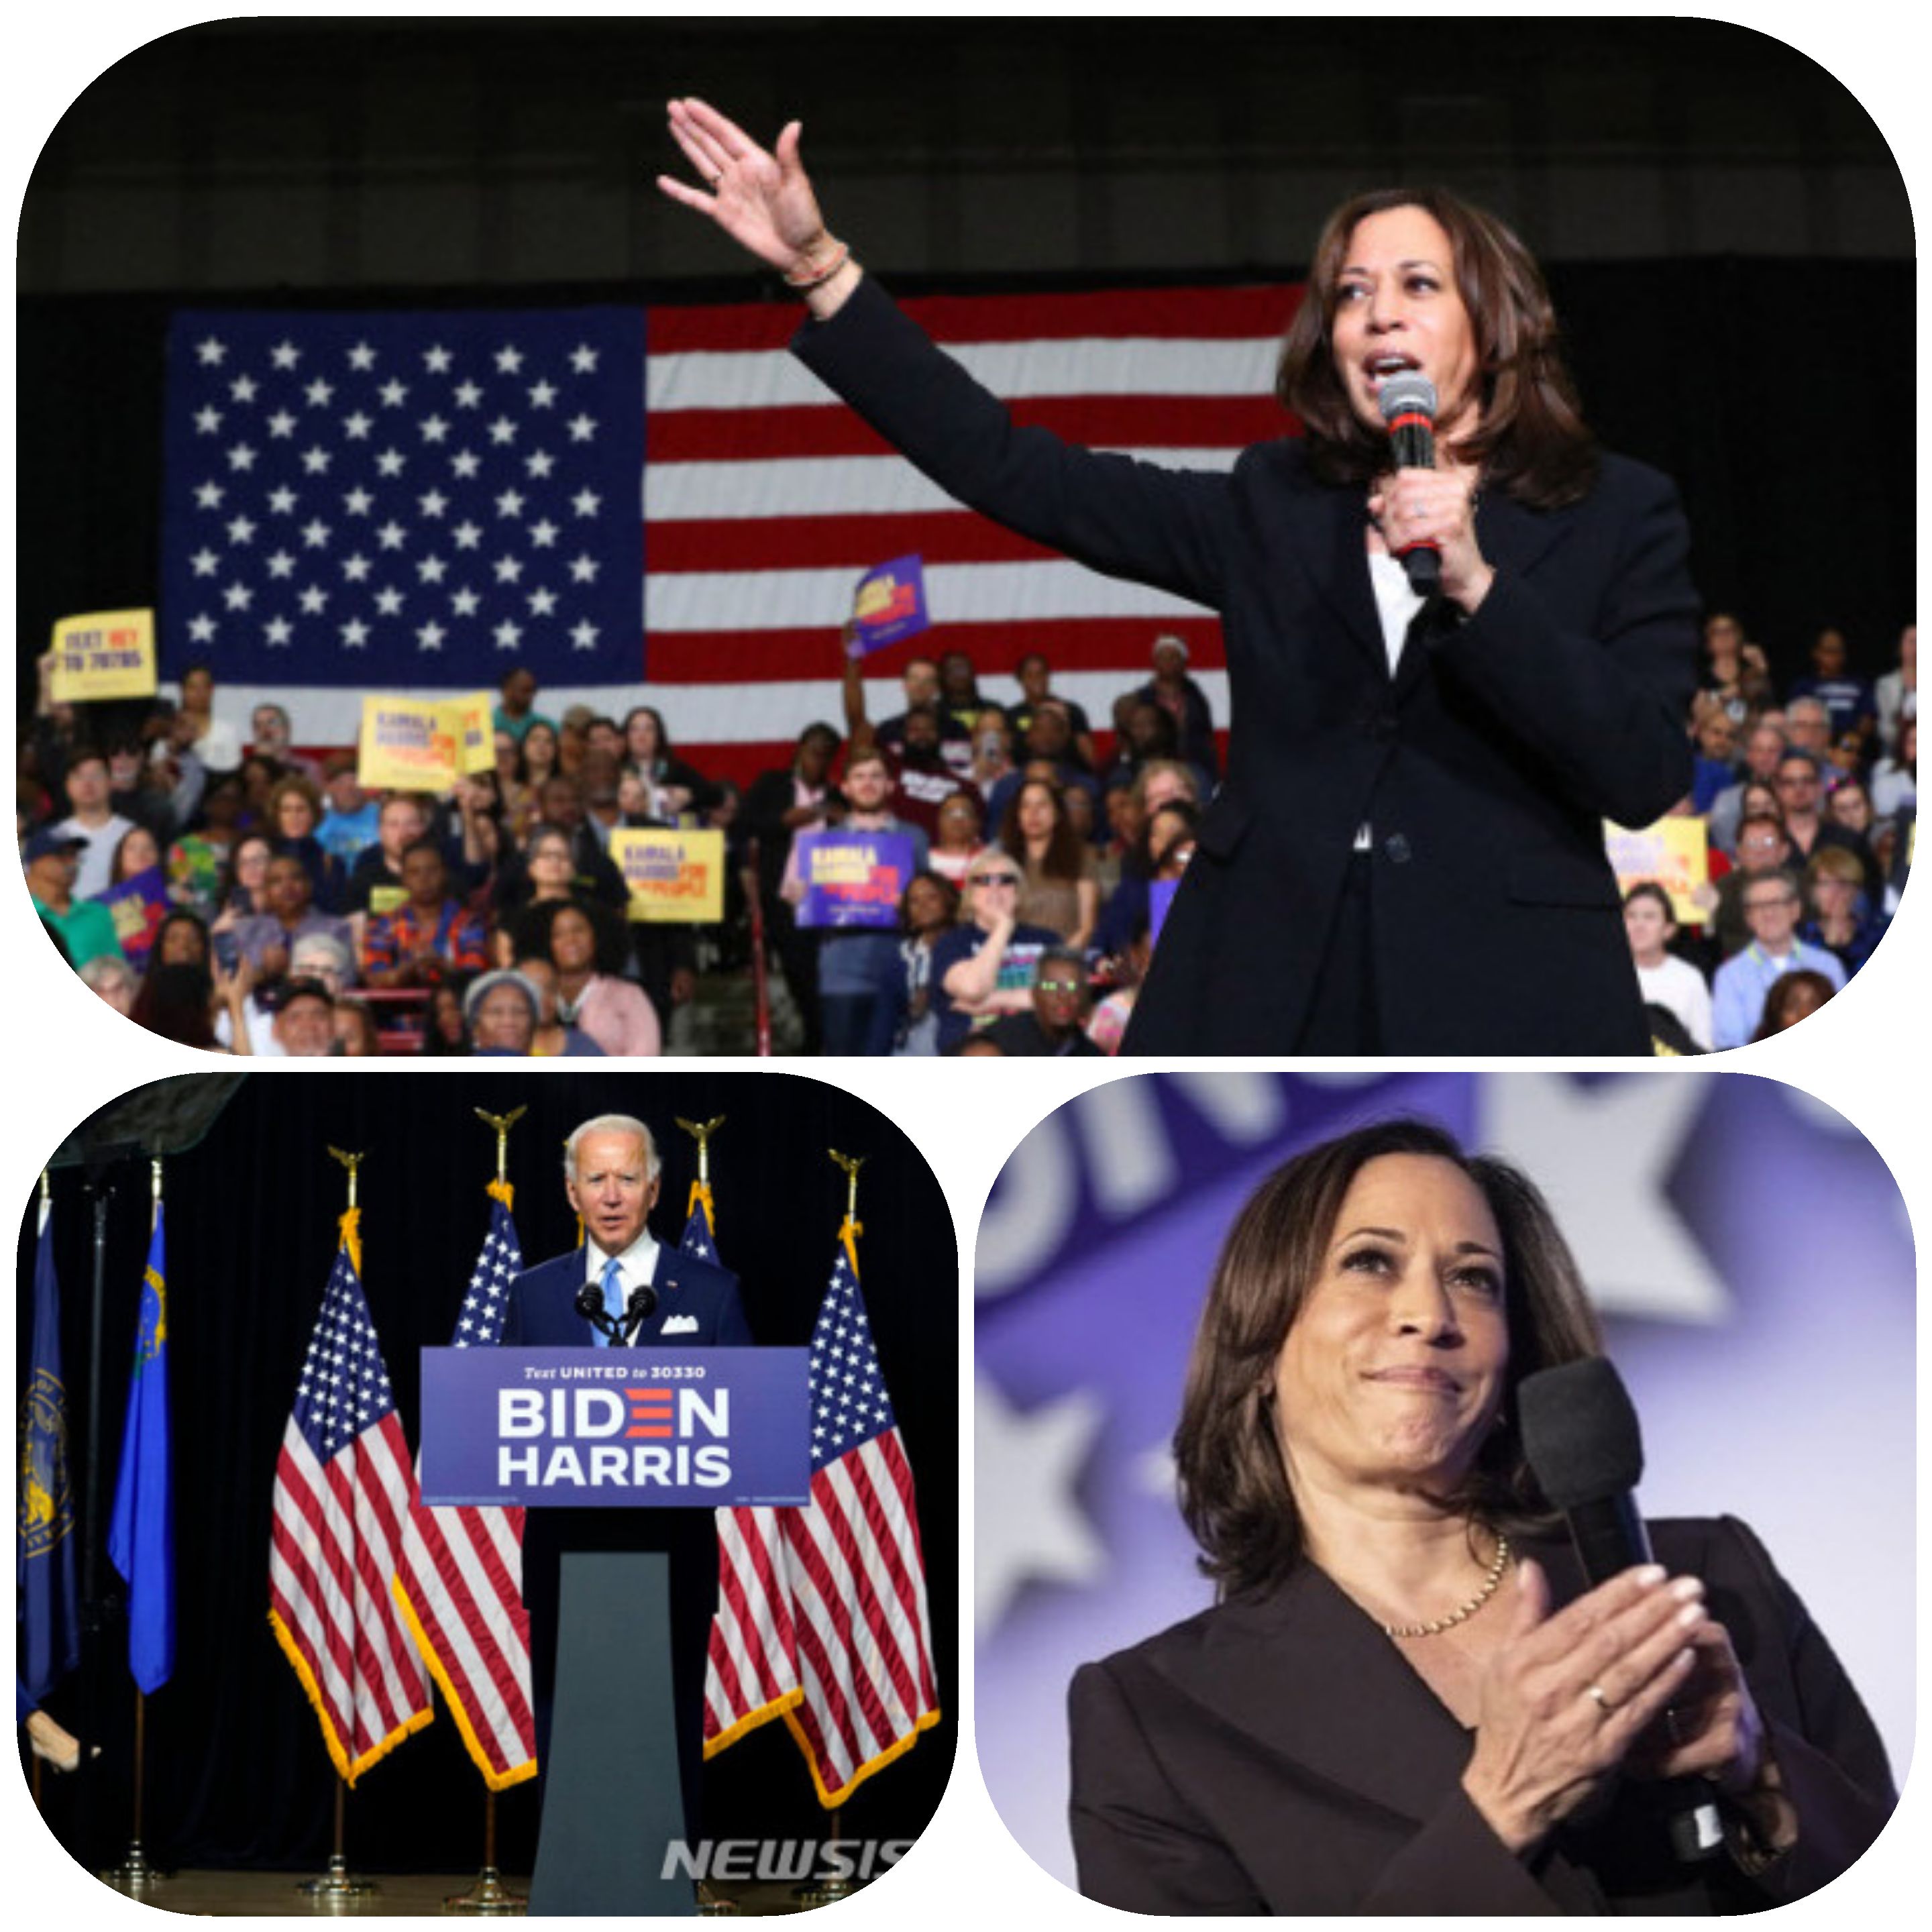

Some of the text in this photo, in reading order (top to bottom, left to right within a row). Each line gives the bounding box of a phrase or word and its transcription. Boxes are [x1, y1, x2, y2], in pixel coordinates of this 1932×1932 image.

[625, 845, 685, 861] KAMALA
[525, 1366, 706, 1379] Text UNITED to 30330
[498, 1388, 729, 1438] BIDEN
[498, 1445, 732, 1487] HARRIS
